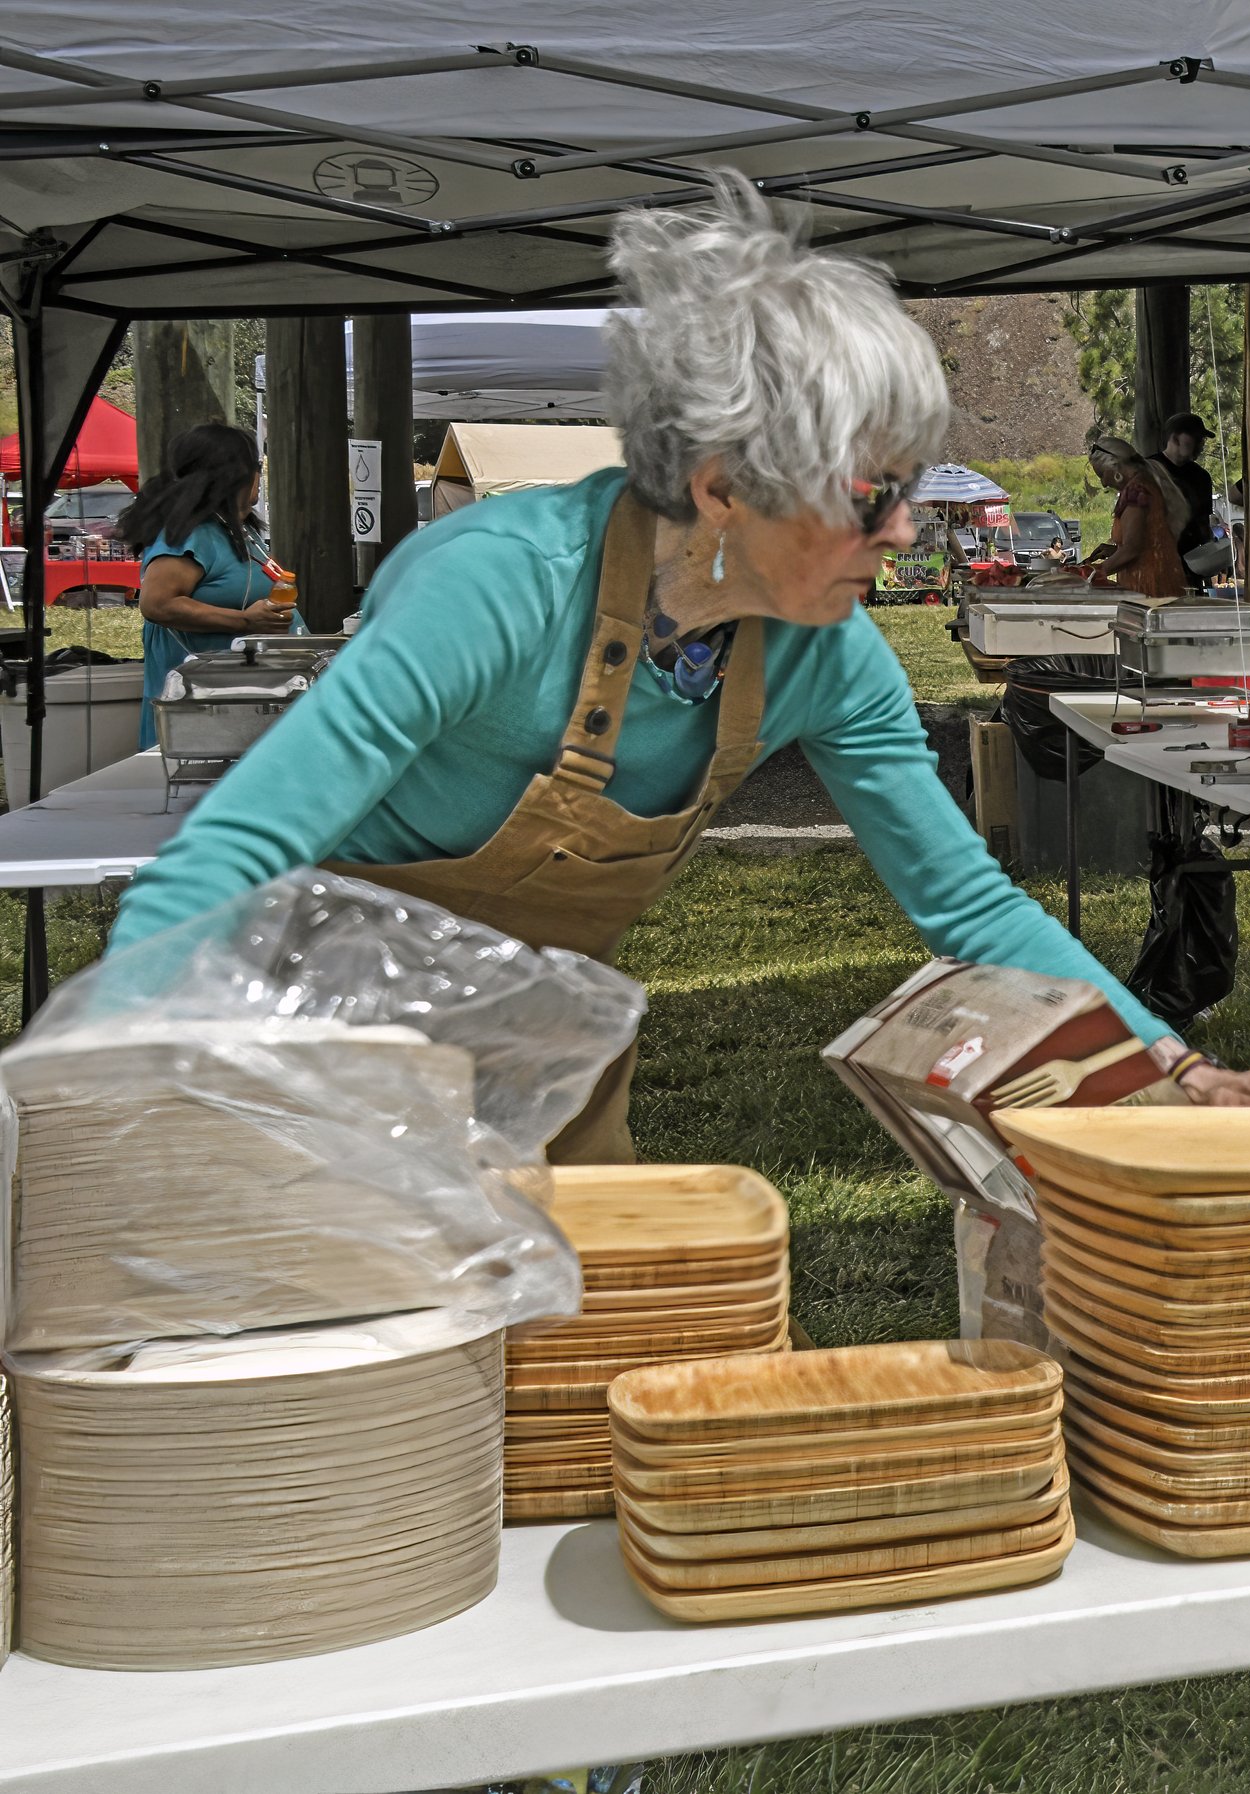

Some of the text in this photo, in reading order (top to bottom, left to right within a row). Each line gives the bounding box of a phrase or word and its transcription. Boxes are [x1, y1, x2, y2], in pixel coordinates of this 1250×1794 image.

[980, 511, 1010, 527] CUPS
[896, 552, 931, 562] FRUIT
[896, 565, 928, 578] CUPS
